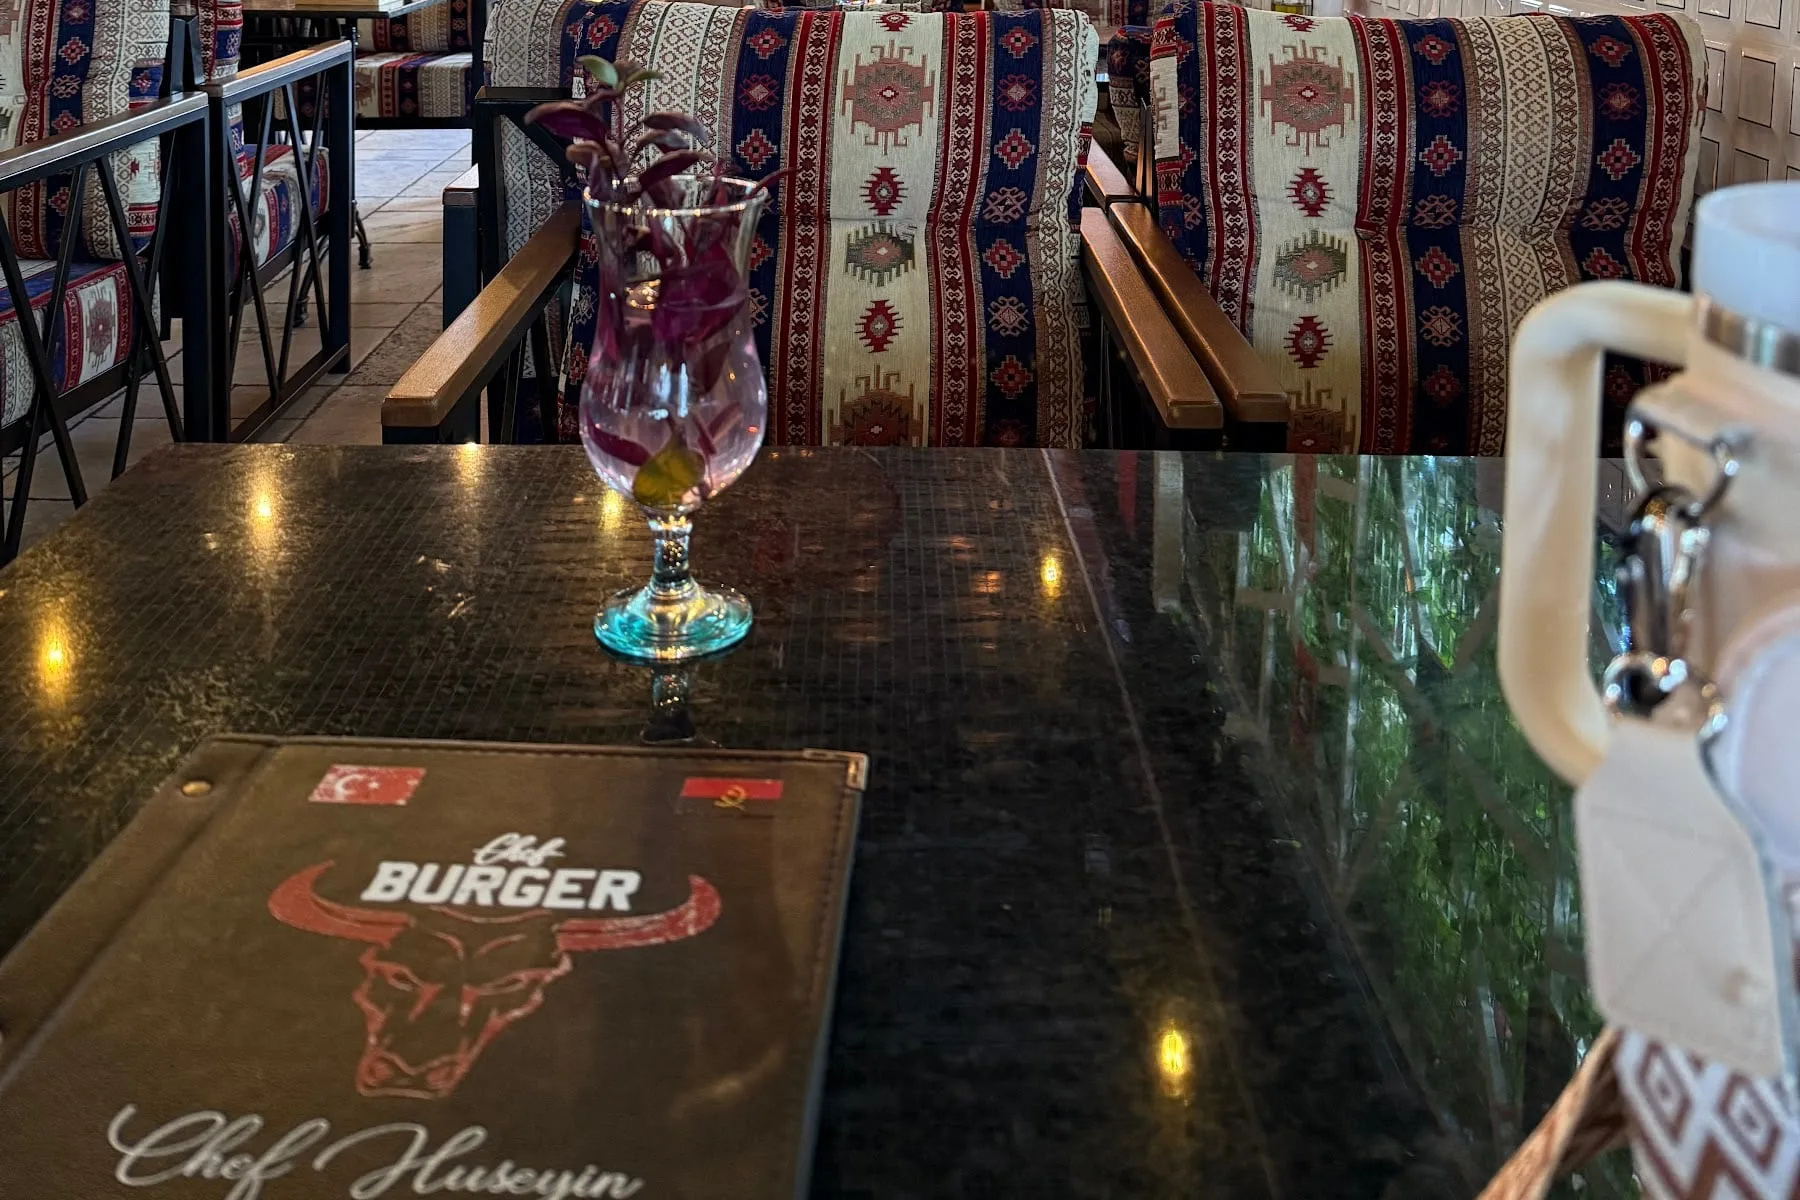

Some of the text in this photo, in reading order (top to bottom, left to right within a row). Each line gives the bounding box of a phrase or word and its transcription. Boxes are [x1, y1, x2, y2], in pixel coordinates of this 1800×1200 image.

[472, 832, 566, 867] Chef
[360, 861, 641, 911] BURGER
[107, 1103, 646, 1200] Chef Huseyin
